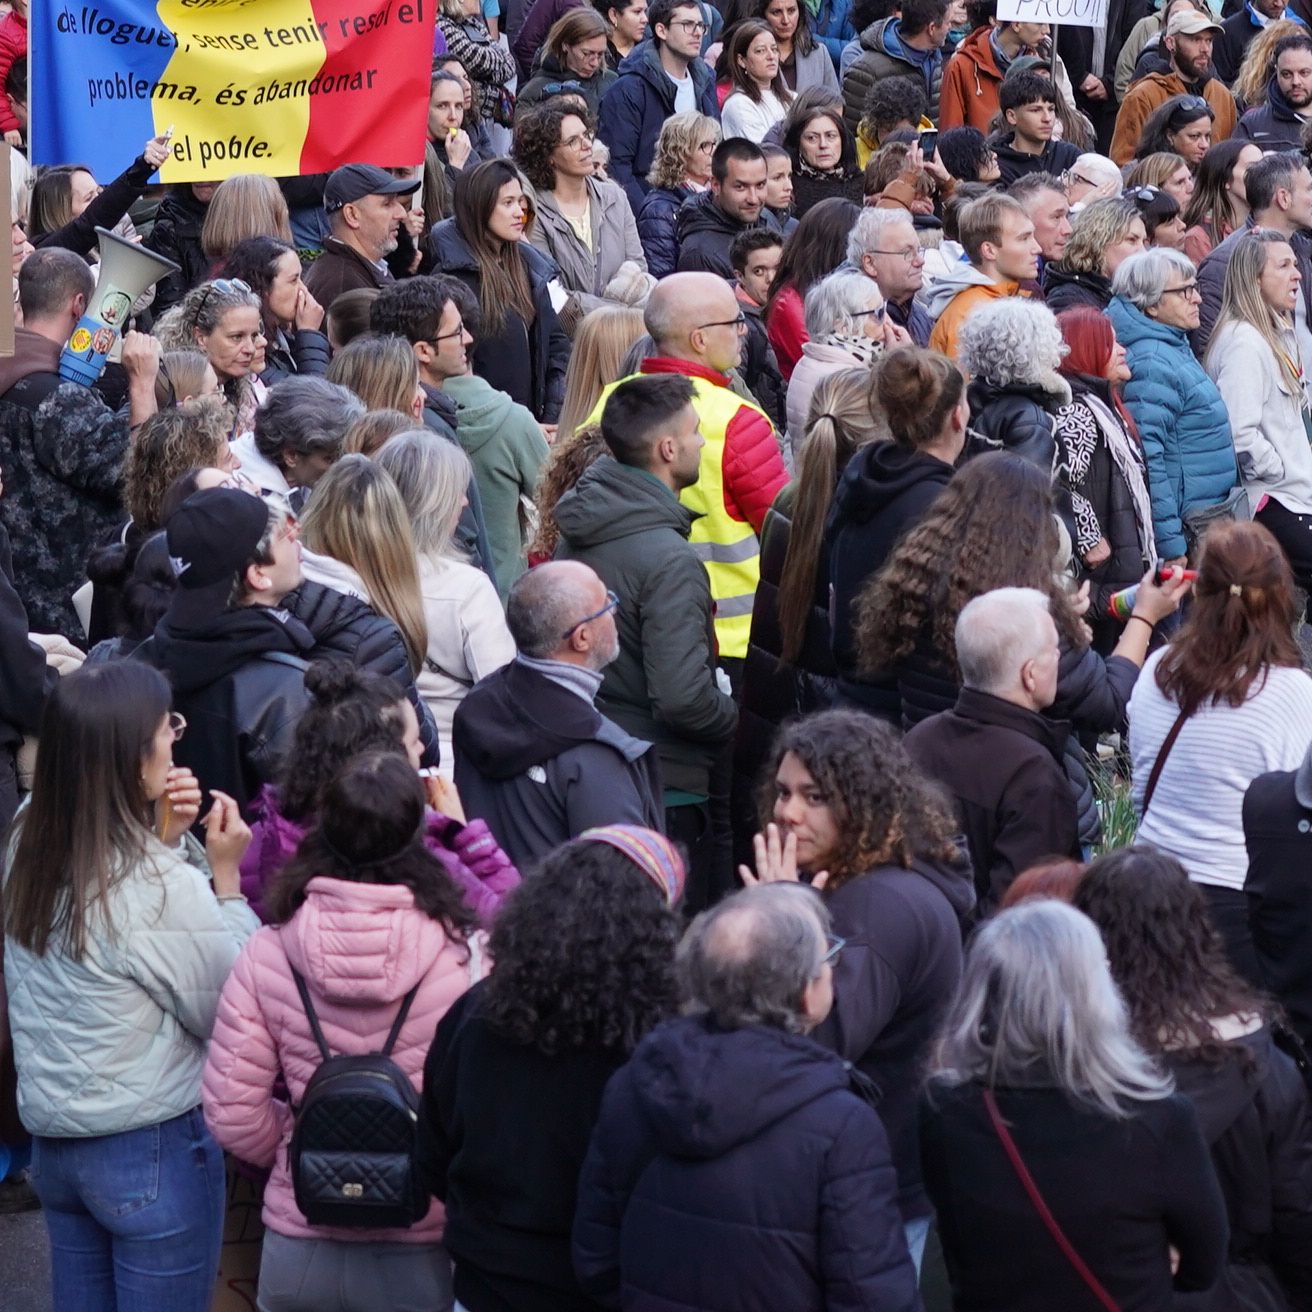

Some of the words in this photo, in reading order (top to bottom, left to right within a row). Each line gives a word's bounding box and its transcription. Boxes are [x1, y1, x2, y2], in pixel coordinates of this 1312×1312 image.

[57, 6, 76, 34] de
[192, 31, 259, 51] sense
[264, 17, 328, 48] tenir
[339, 0, 392, 38] resol
[88, 72, 202, 107] problema,
[215, 83, 247, 106] és
[253, 67, 378, 106] abandonar
[173, 134, 192, 162] el
[199, 135, 273, 169] poble.
